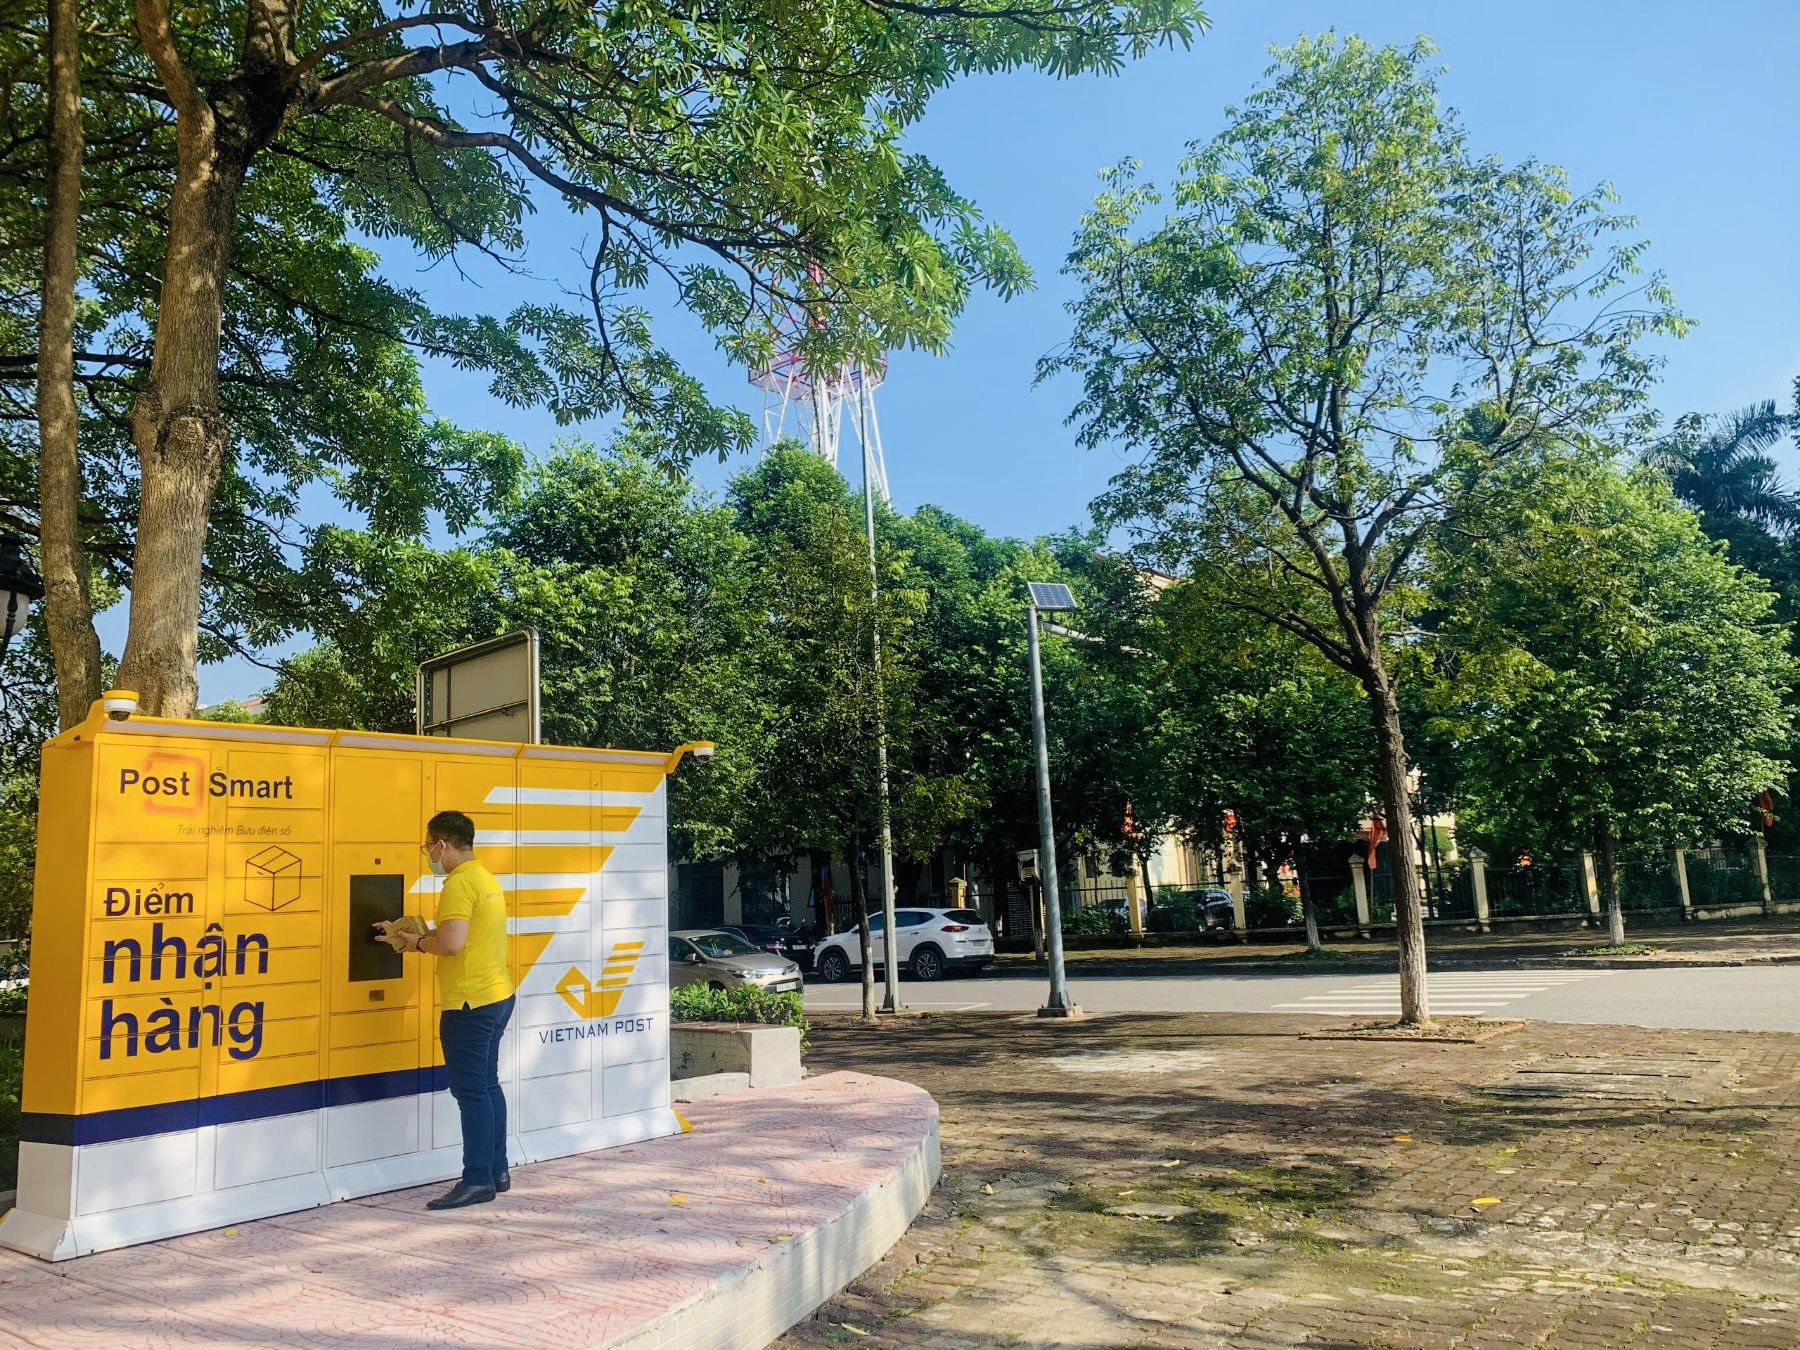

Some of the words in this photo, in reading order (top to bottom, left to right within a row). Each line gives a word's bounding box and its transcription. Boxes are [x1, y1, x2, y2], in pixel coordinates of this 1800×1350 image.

[120, 768, 190, 796] Post
[209, 772, 293, 800] Smart
[103, 882, 194, 917] Điểm
[102, 922, 269, 990] nhận
[99, 997, 265, 1061] hàng
[538, 1022, 609, 1044] VIETNAM
[615, 1017, 654, 1035] POST
